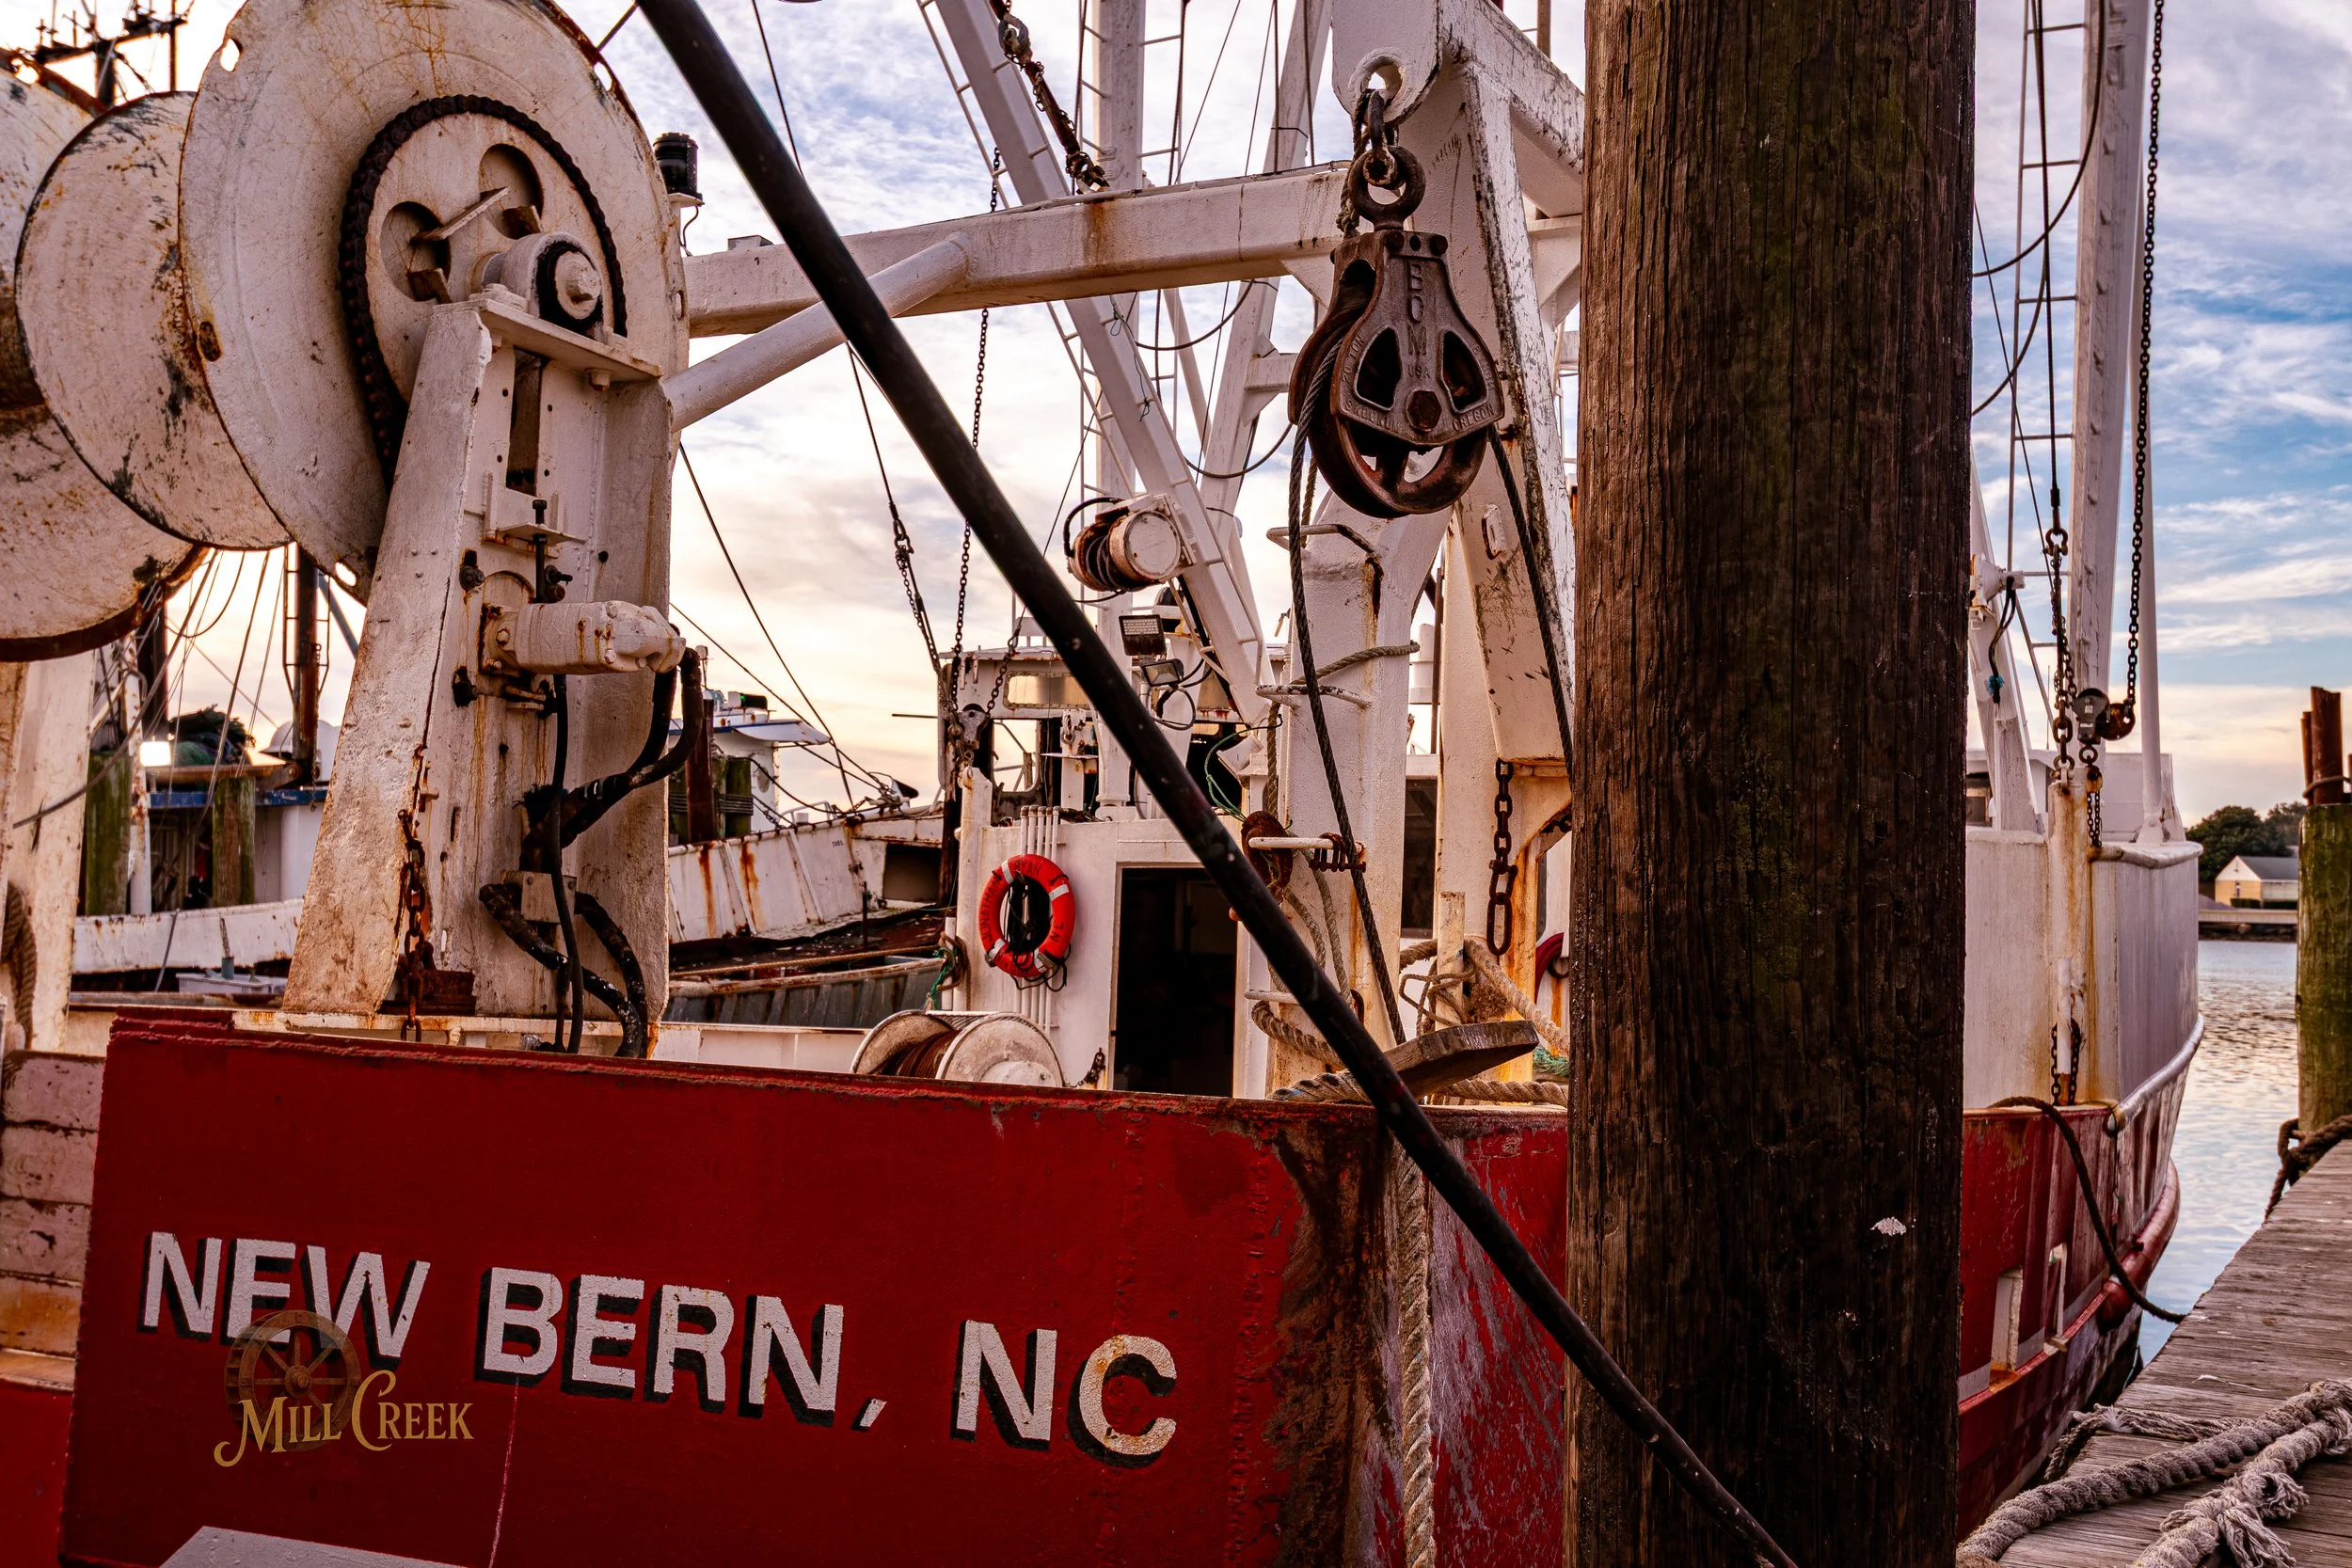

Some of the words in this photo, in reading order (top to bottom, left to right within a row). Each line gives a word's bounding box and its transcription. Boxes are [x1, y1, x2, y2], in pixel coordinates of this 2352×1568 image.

[1348, 335, 1365, 360] TON
[1407, 364, 1431, 380] USA
[1453, 404, 1495, 433] OREGON
[1014, 860, 1042, 877] RYAN
[141, 1231, 431, 1364] NEW
[478, 1266, 887, 1429] BERN,
[953, 1319, 1177, 1462] NC
